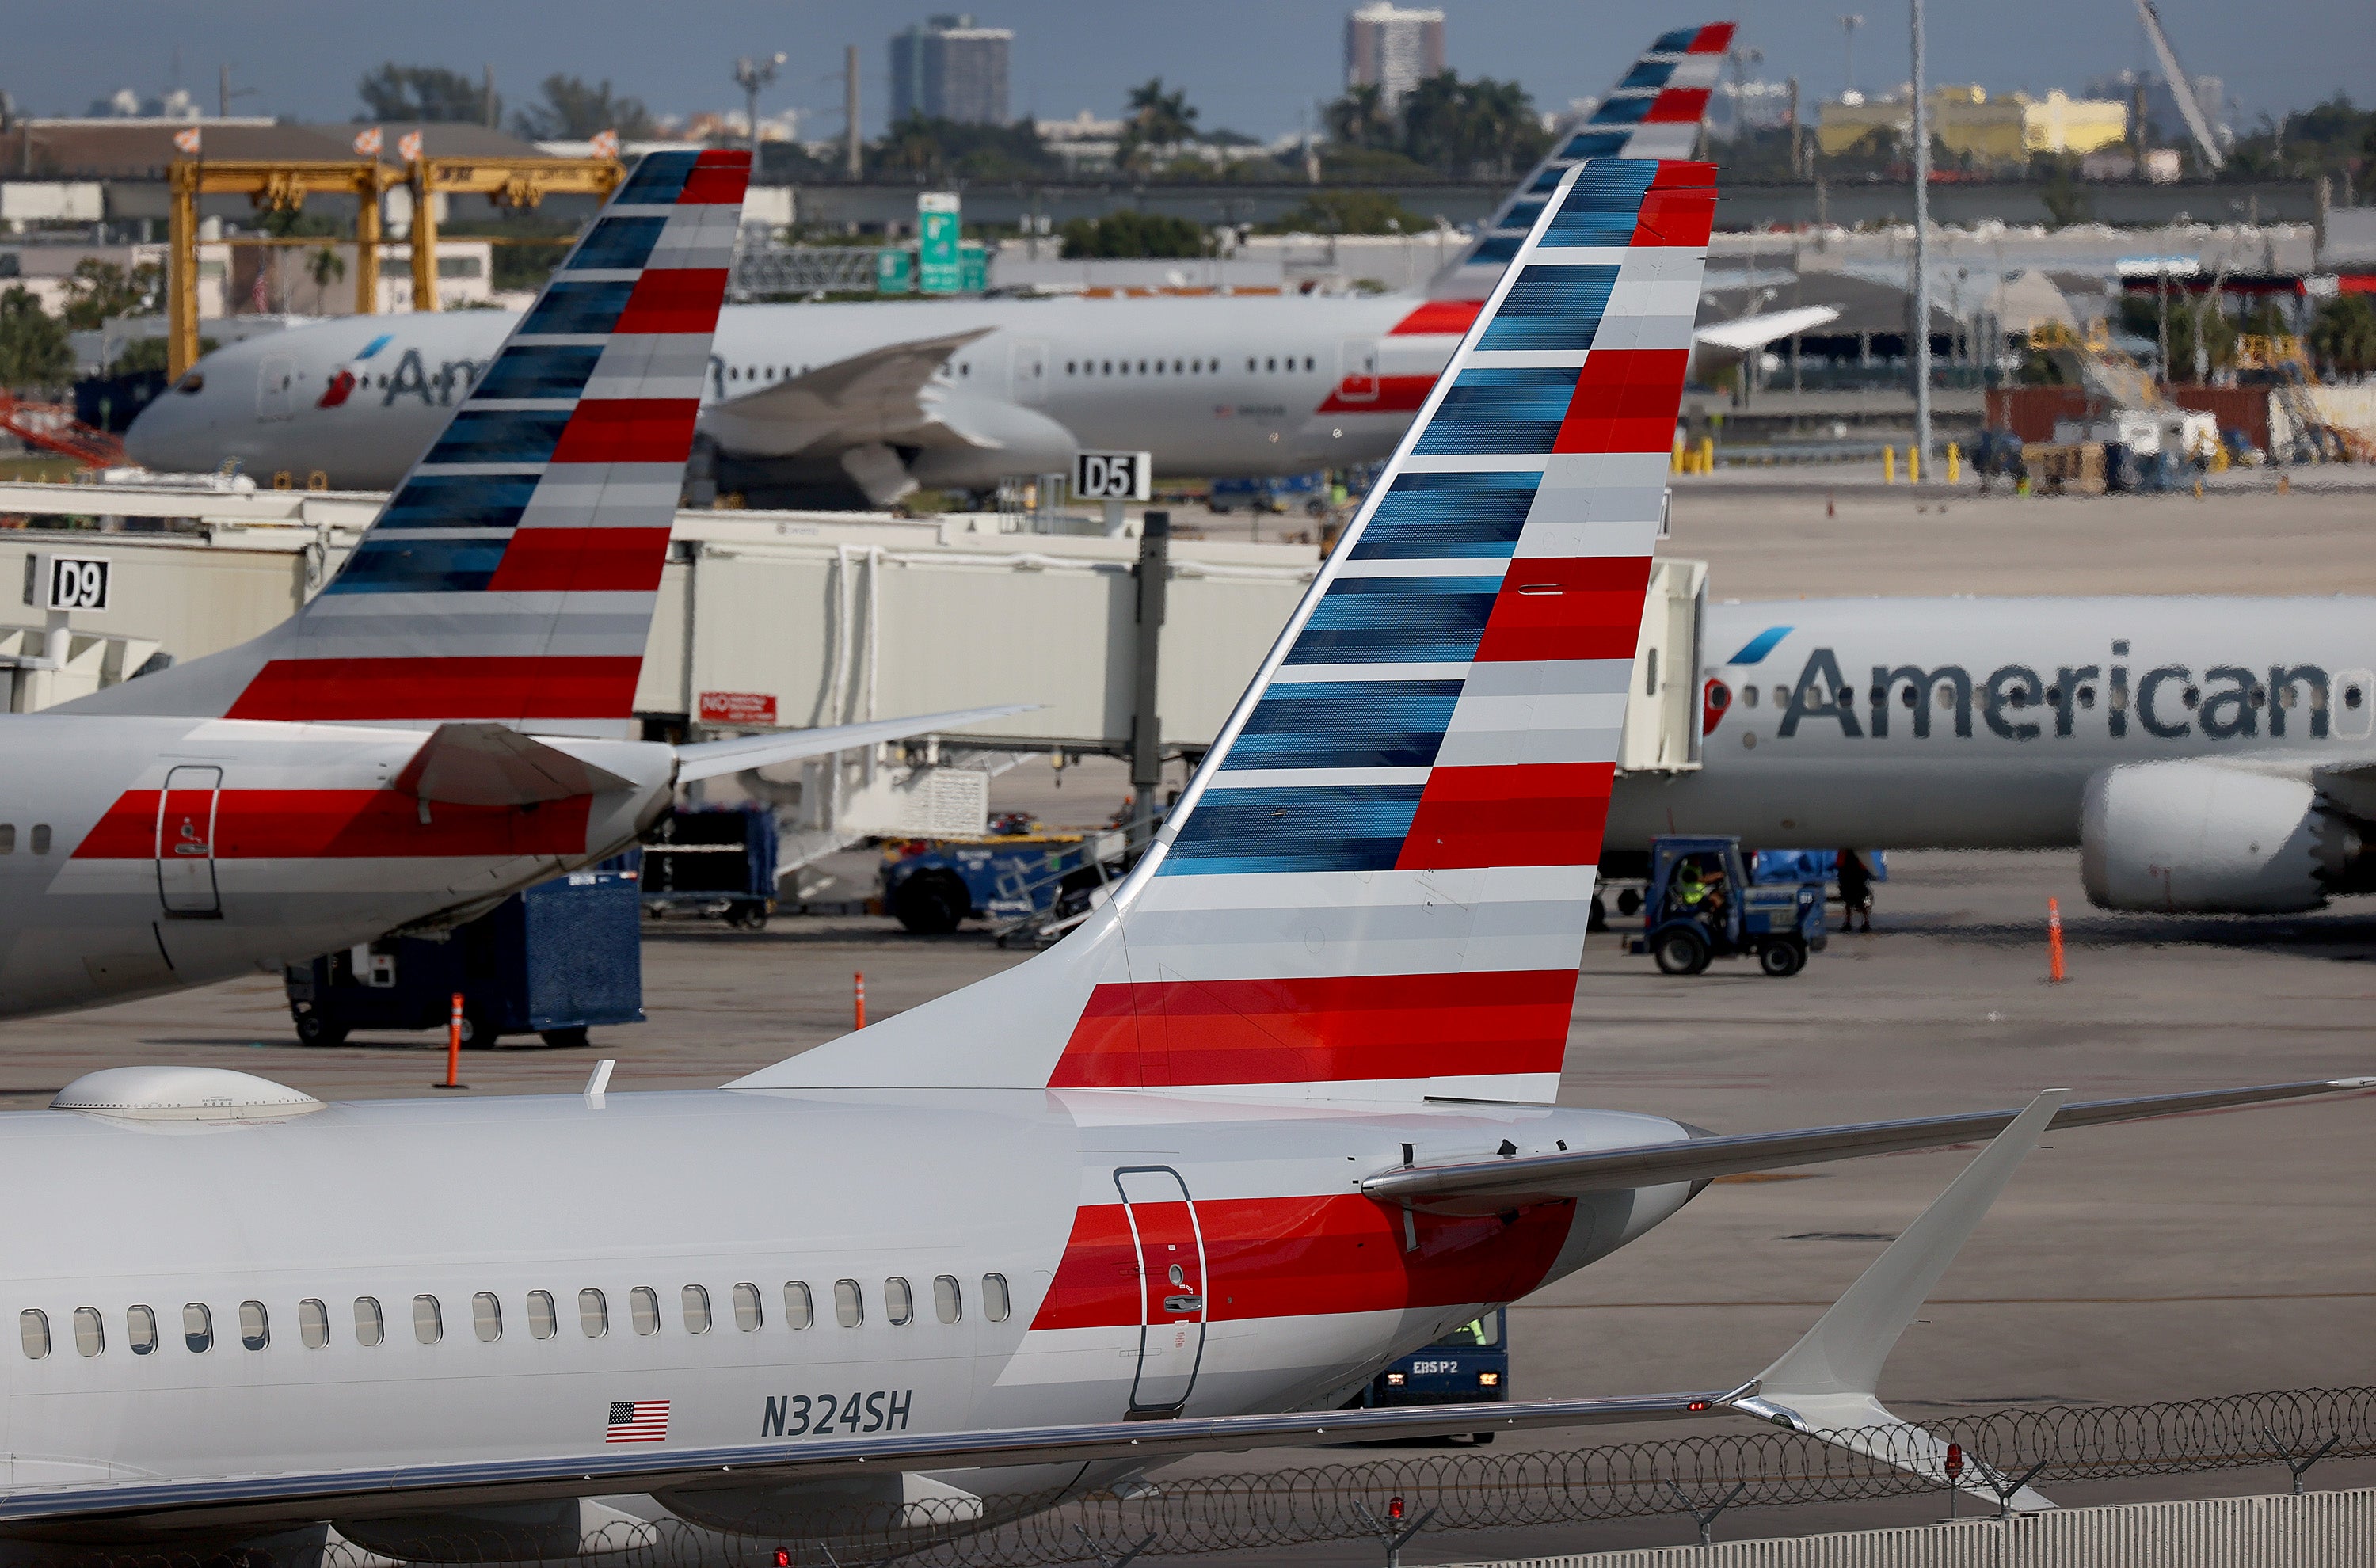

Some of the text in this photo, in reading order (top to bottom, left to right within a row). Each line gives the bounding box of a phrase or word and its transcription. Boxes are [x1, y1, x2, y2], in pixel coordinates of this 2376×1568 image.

[1086, 456, 1131, 497] D5
[58, 560, 101, 609] D9
[703, 695, 729, 712] NO
[1777, 637, 2331, 740] American
[760, 1389, 912, 1437] N324SH
